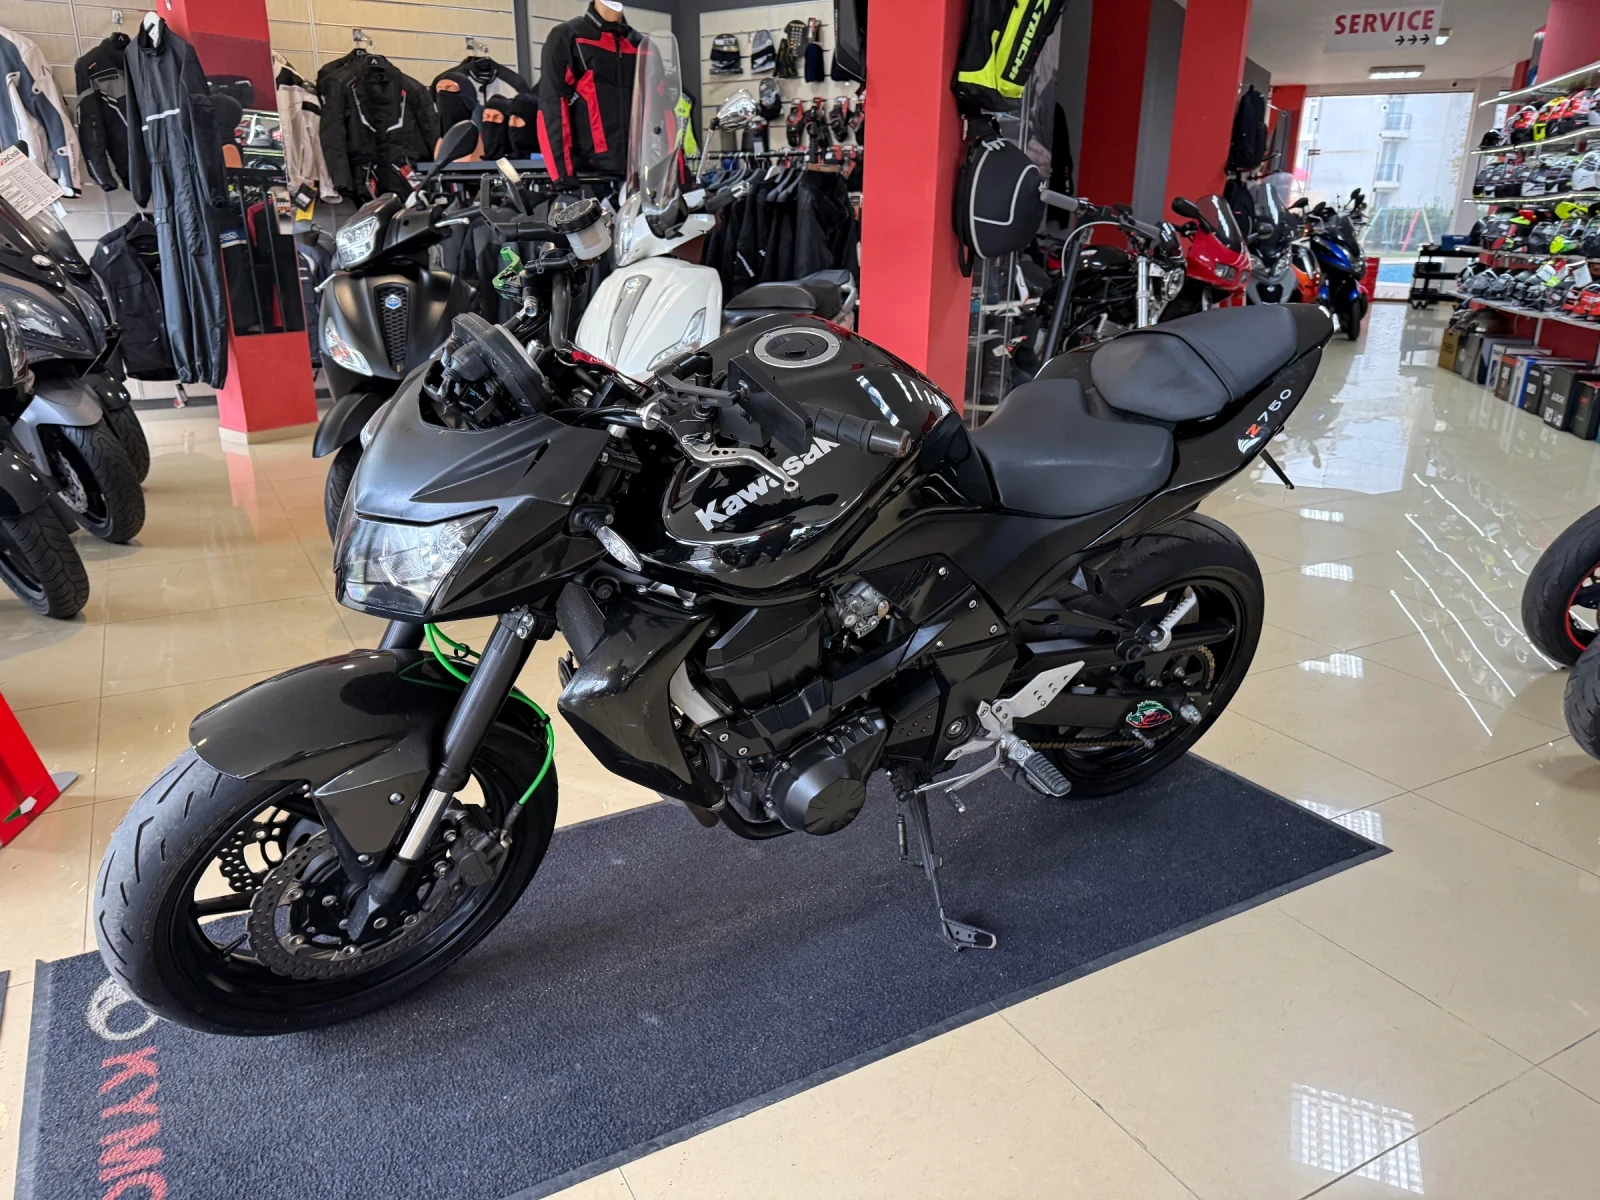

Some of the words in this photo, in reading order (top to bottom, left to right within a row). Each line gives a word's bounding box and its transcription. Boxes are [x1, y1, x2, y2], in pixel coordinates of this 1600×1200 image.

[1008, 11, 1042, 81] TAICHI
[1334, 9, 1435, 35] SERVICE
[1245, 388, 1292, 438] Z750
